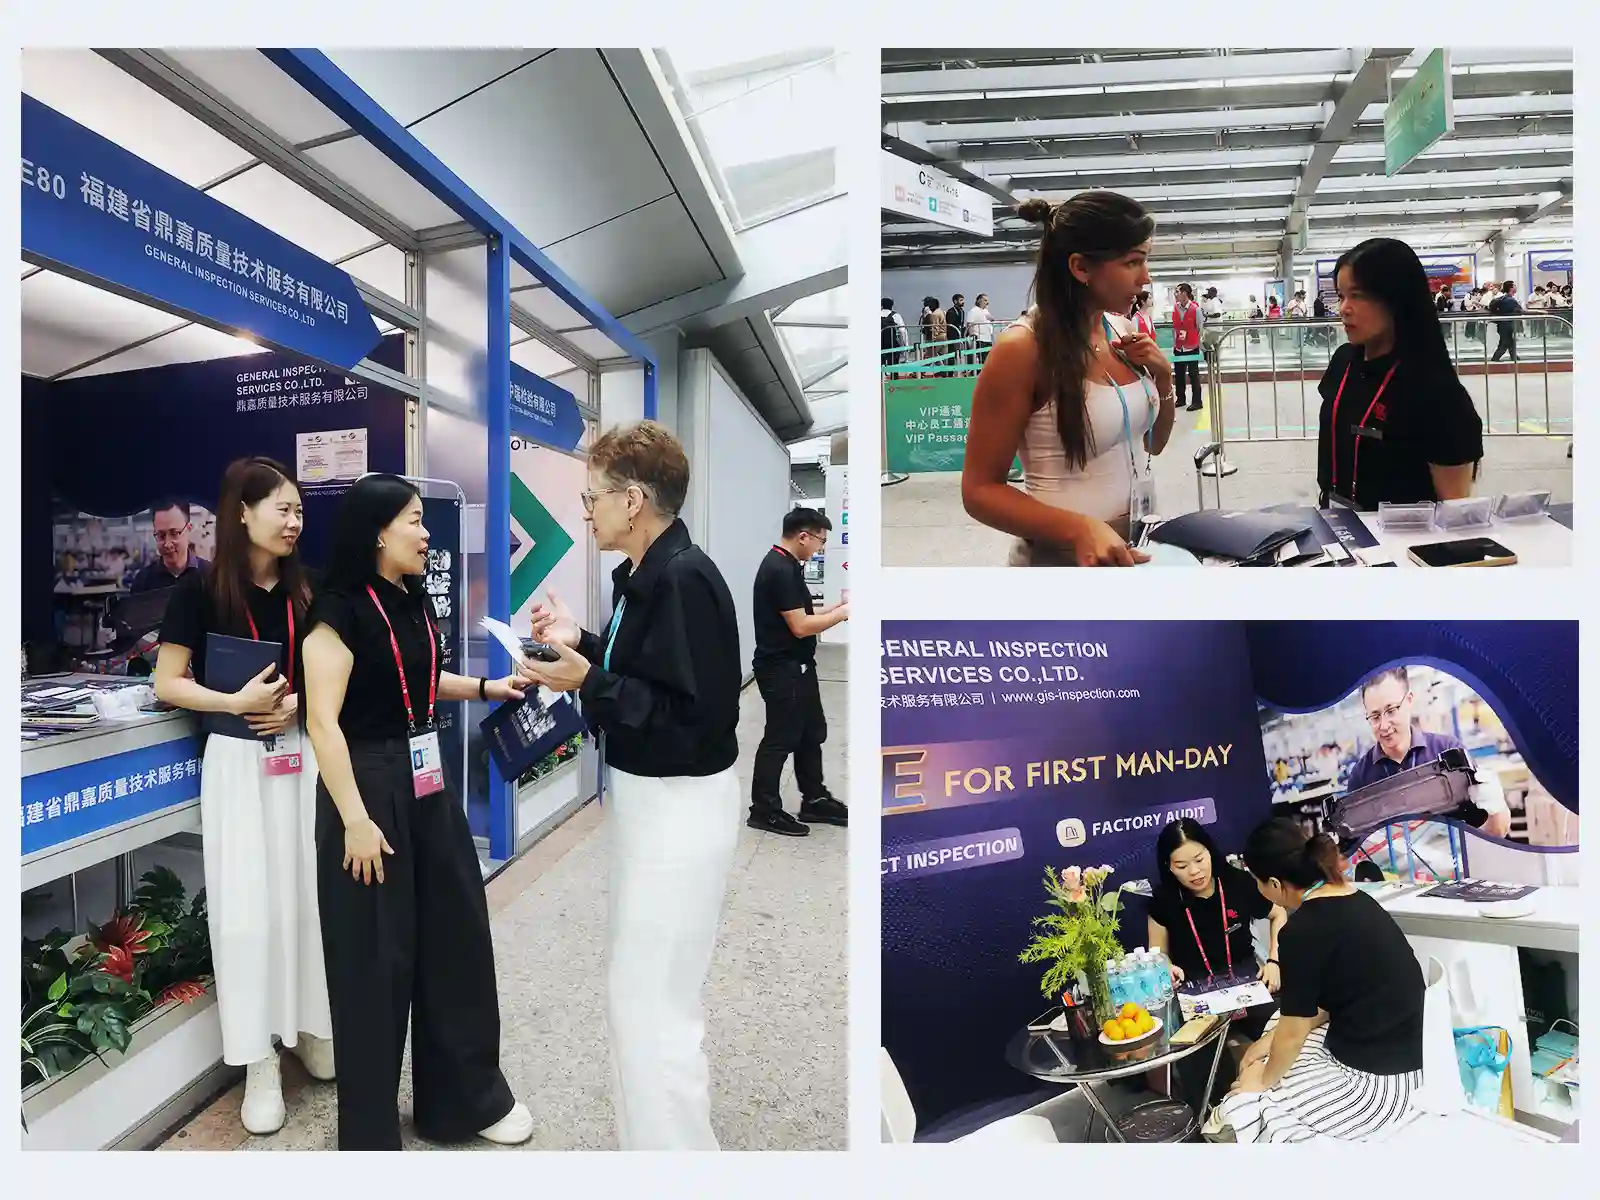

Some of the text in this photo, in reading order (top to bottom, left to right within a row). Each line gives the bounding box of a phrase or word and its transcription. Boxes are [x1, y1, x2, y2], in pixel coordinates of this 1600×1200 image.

[80, 171, 348, 325] 福建省鼎嘉质量技术服务有限公司
[144, 244, 193, 275] GENERAL
[195, 265, 248, 298] INSPECTION
[249, 290, 287, 316] SERVICES
[236, 364, 327, 383] GENERAL INSPEC
[236, 377, 325, 396] SERVICES CO.,LTD.
[236, 386, 368, 413] 鼎嘉质量技术服务有限公司
[919, 404, 963, 417] VIP通道
[905, 432, 969, 444] VIP Passag
[989, 641, 1108, 658] INSPECTION
[998, 665, 1085, 684] CO.,LTD.
[1001, 687, 1141, 706] www.gis-inspection.com
[944, 766, 1015, 797] FOR
[1026, 755, 1107, 787] FIRST
[1115, 743, 1233, 778] MAN-DAY
[1092, 806, 1205, 836] FACTORY AUDIT
[906, 837, 1018, 870] INSPECTION
